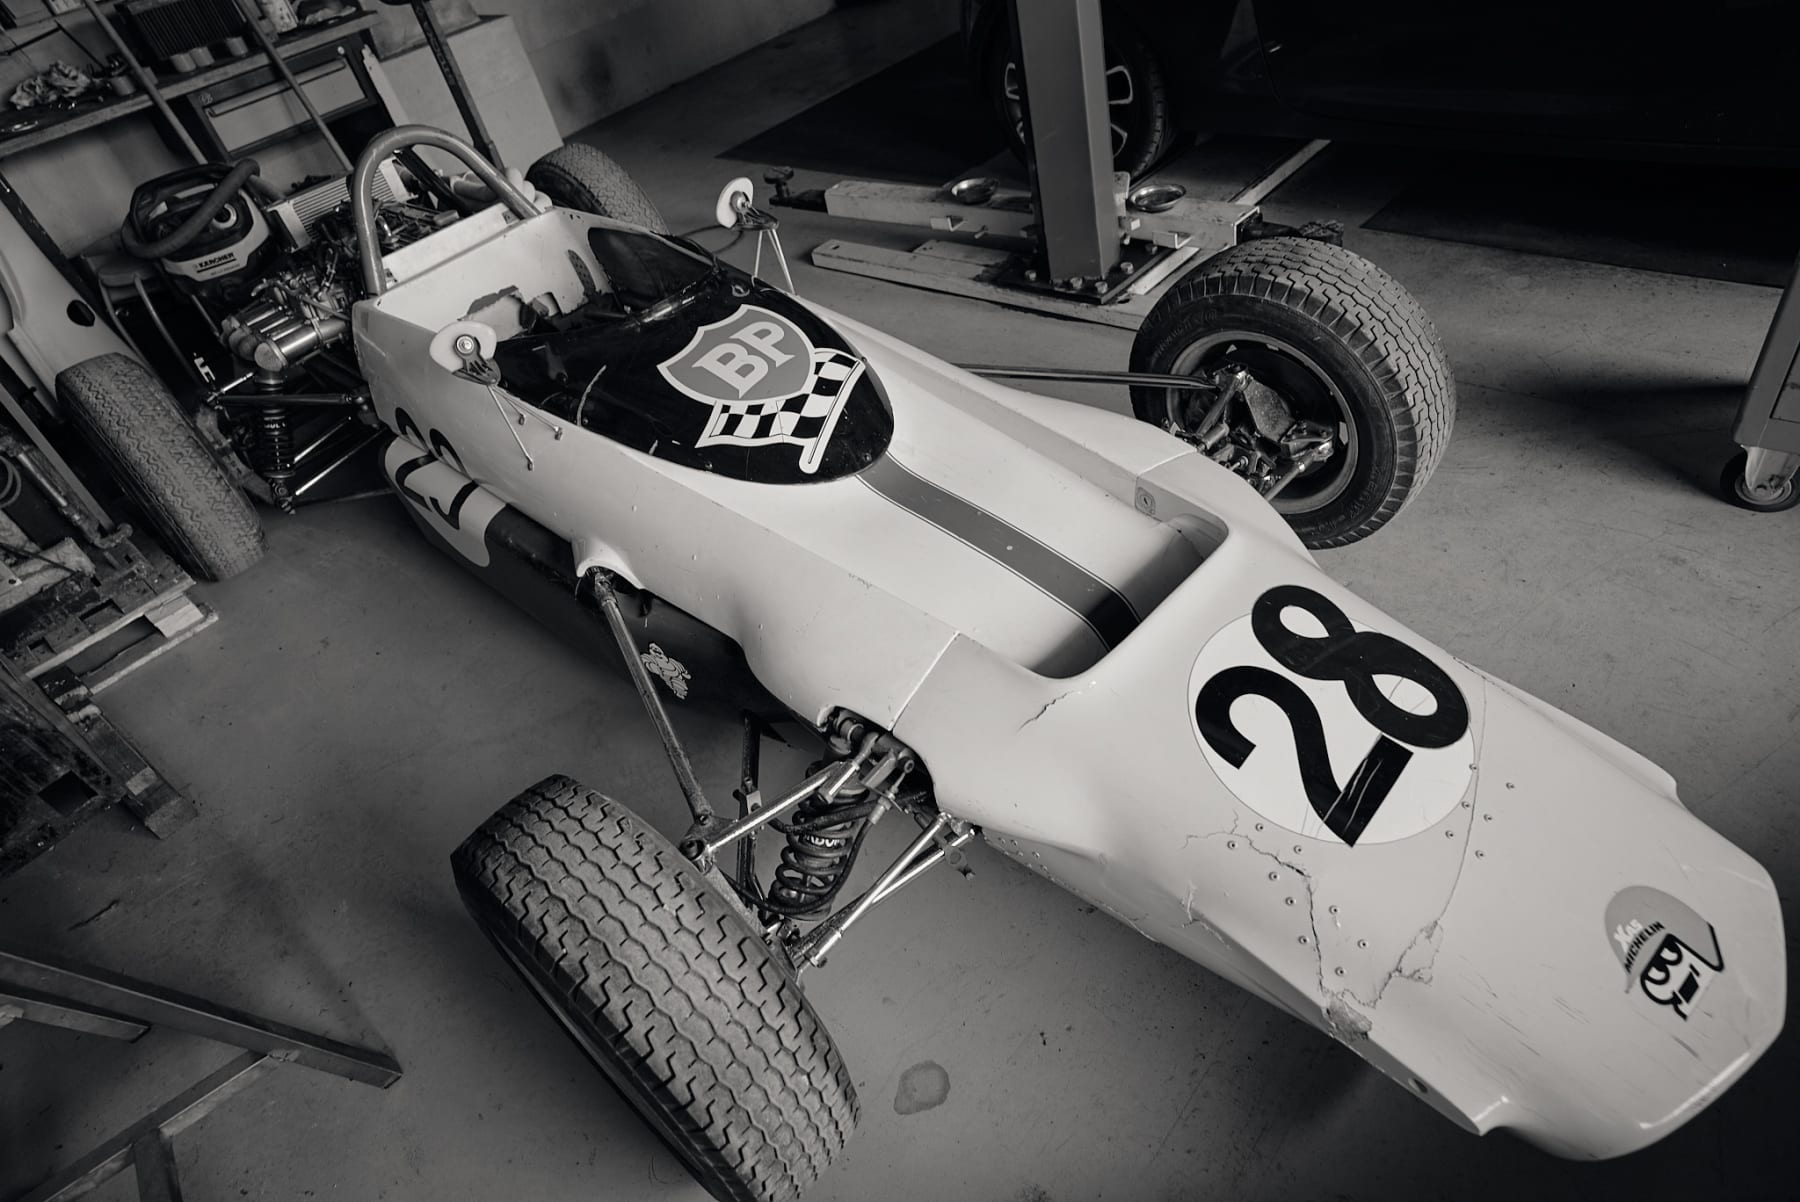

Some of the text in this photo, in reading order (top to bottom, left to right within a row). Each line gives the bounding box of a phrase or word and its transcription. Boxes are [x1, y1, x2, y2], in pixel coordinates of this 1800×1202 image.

[691, 321, 797, 399] BP
[1195, 584, 1469, 848] 28
[1624, 921, 1666, 975] MICHELIN
